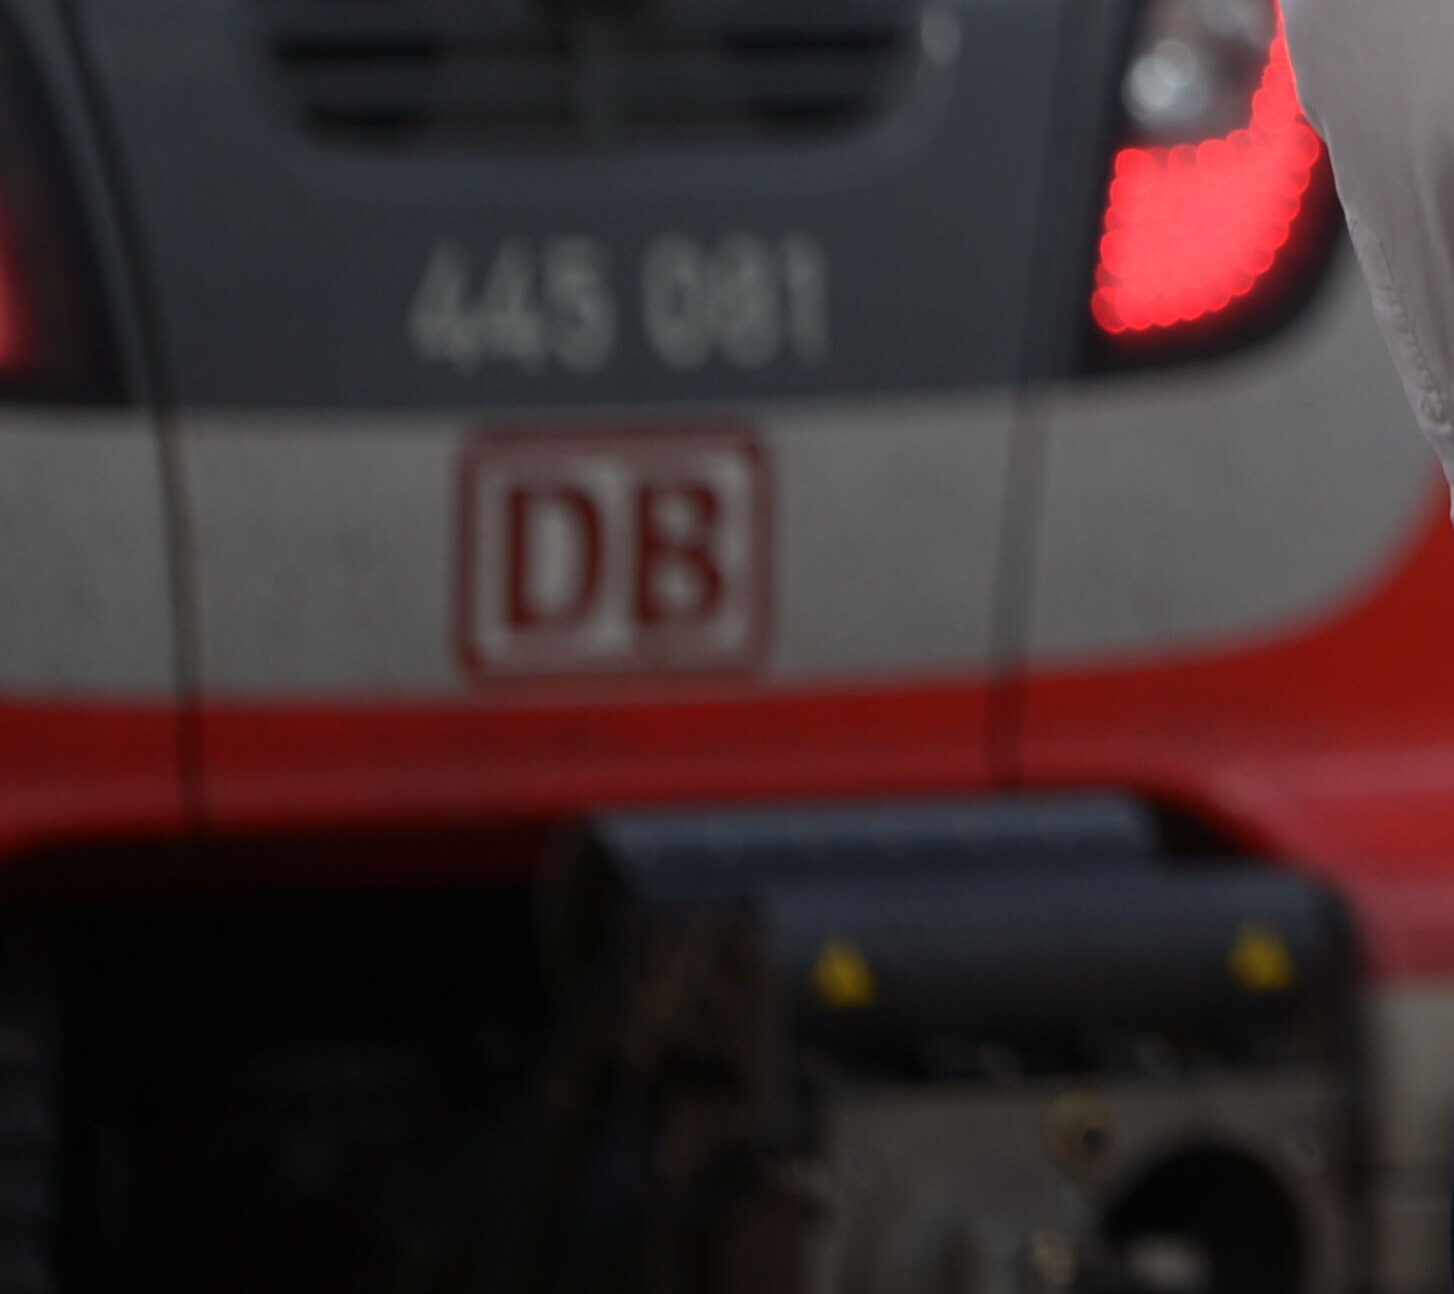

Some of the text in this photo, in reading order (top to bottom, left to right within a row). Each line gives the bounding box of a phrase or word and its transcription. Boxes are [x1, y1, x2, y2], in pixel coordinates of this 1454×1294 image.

[410, 231, 832, 374] 445 081
[506, 478, 726, 630] DB
